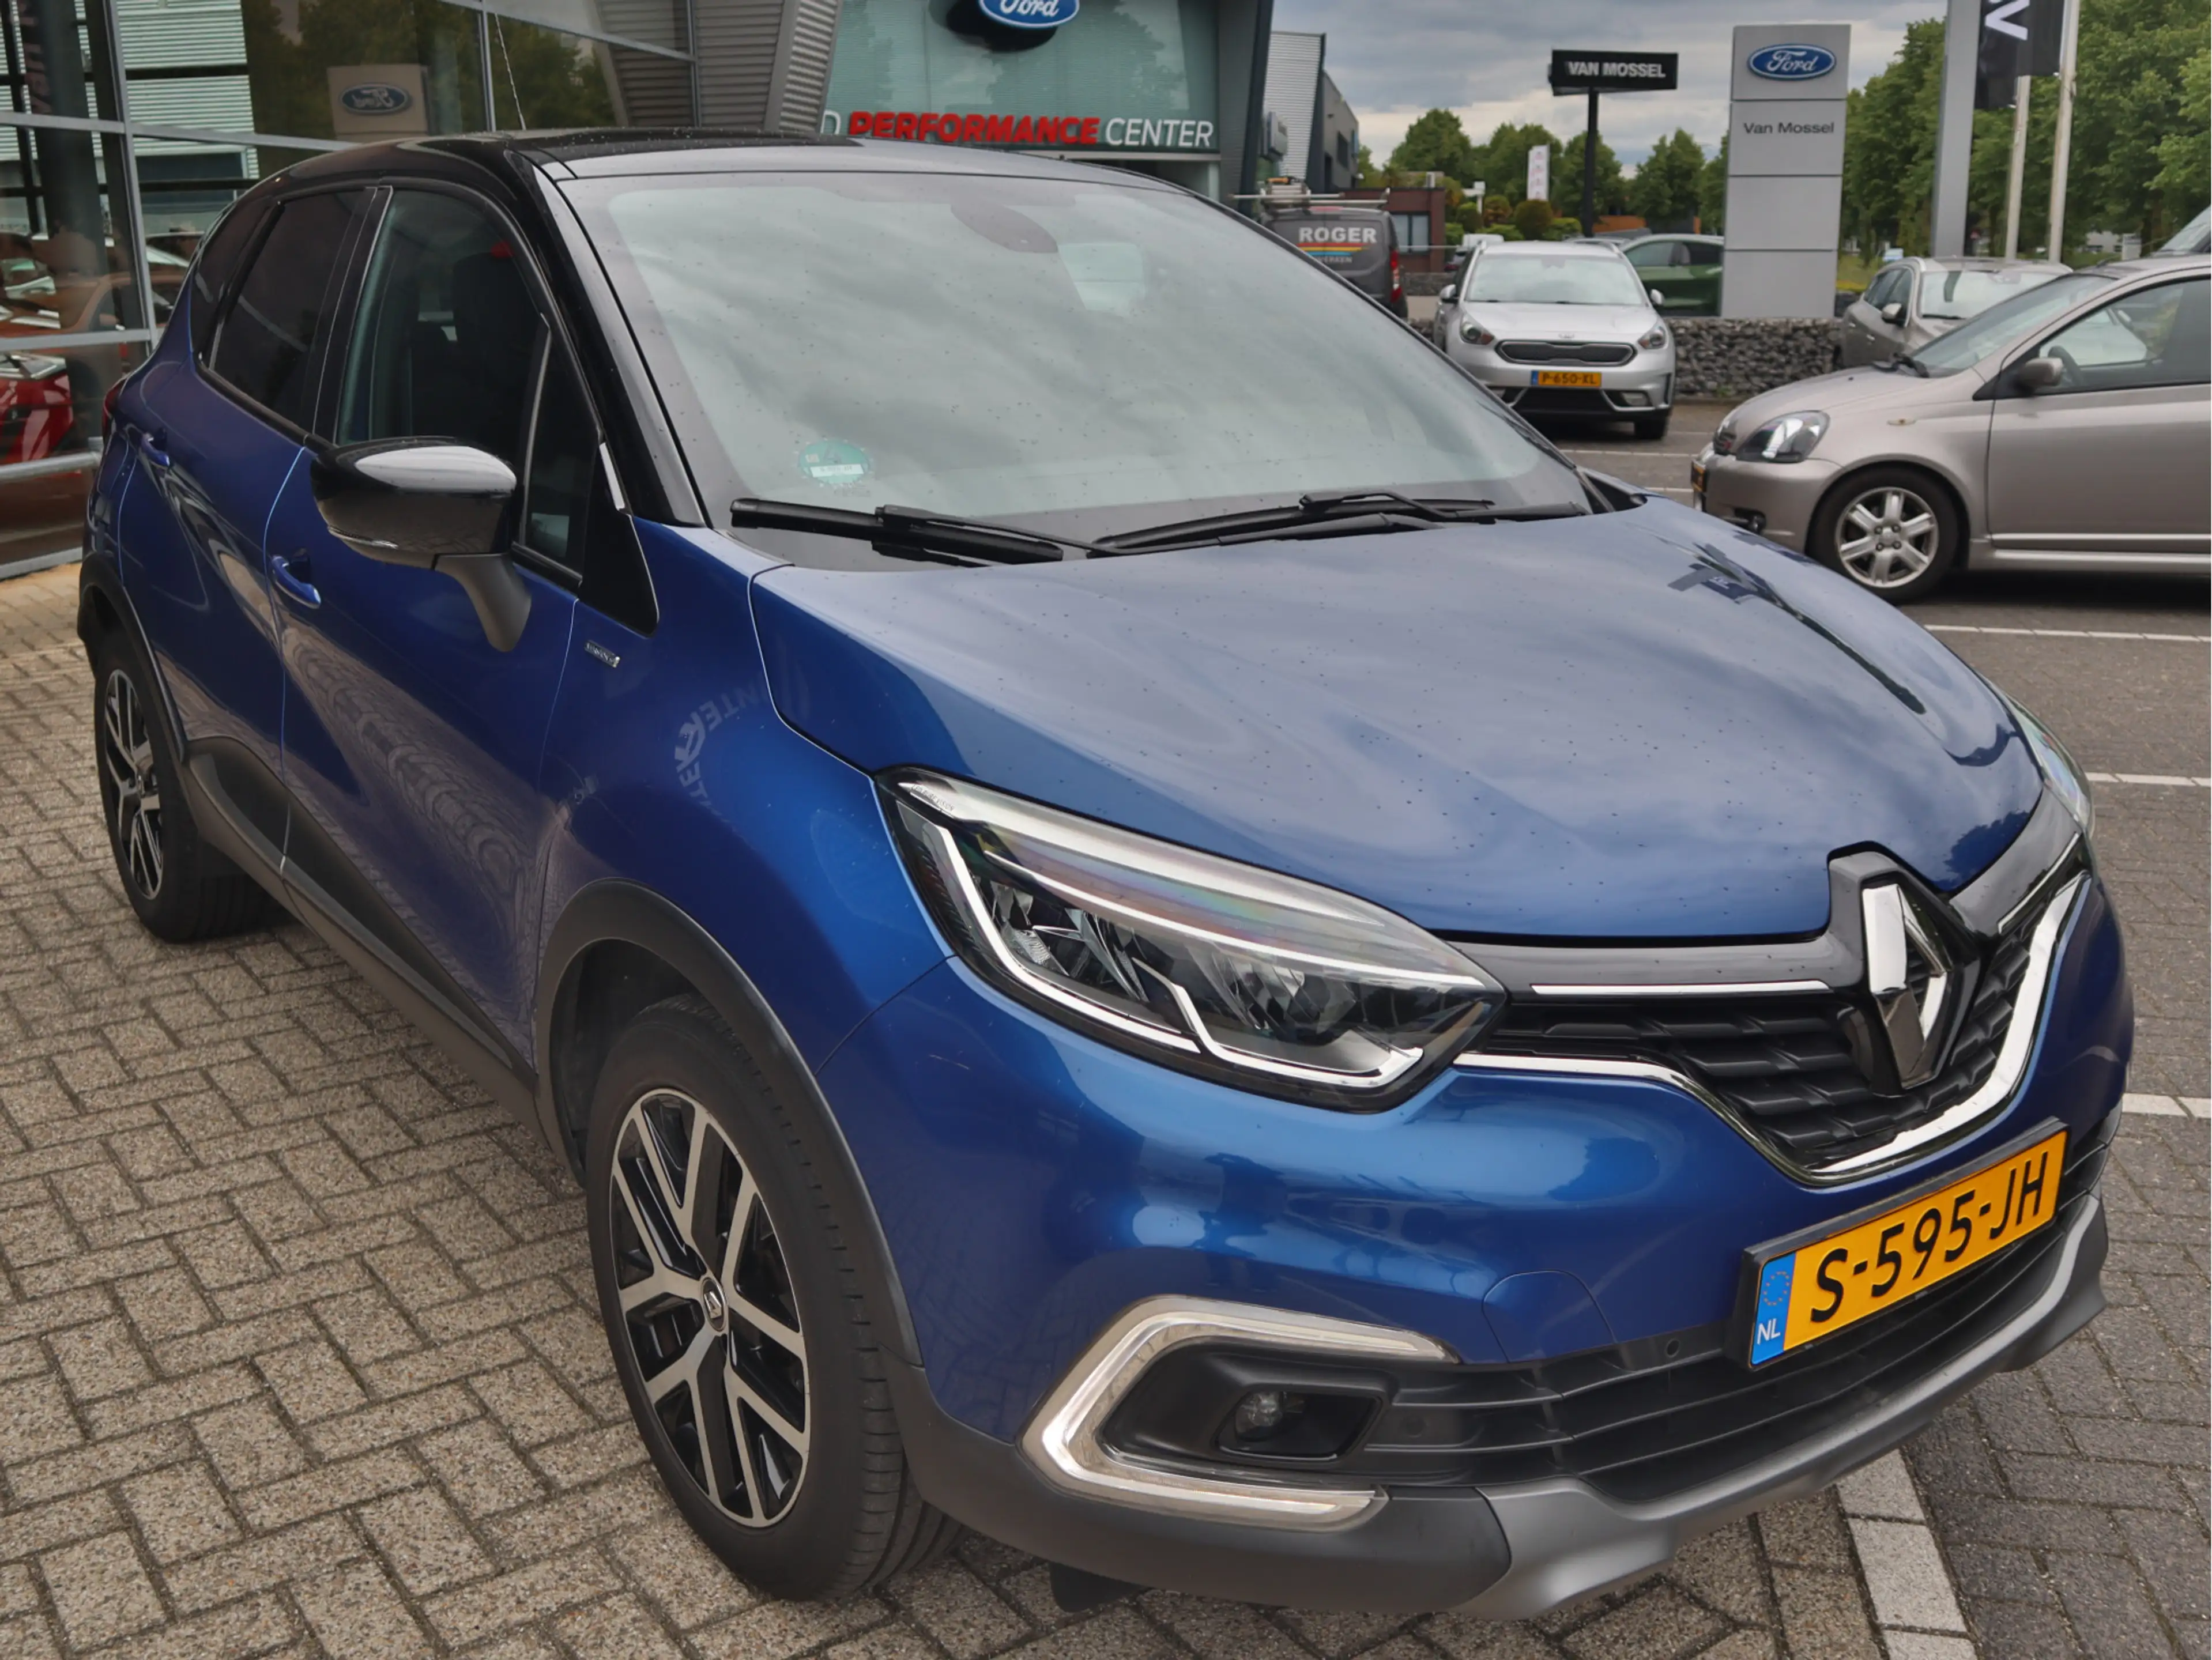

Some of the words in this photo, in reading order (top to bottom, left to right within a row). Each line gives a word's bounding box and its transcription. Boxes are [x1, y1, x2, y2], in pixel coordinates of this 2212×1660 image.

[1000, 0, 1060, 17] Ford
[1567, 61, 1599, 76] VAN
[1602, 62, 1665, 78] MOSSEL
[1766, 50, 1819, 71] Ford
[849, 111, 1100, 144] PERFORMANCE
[1105, 117, 1214, 148] CENTER
[1743, 122, 1773, 134] Van
[1778, 122, 1834, 134] Mossel
[1298, 227, 1377, 243] ROGER
[1810, 1152, 2048, 1323] S-595-JH
[1757, 1318, 1781, 1345] NL
